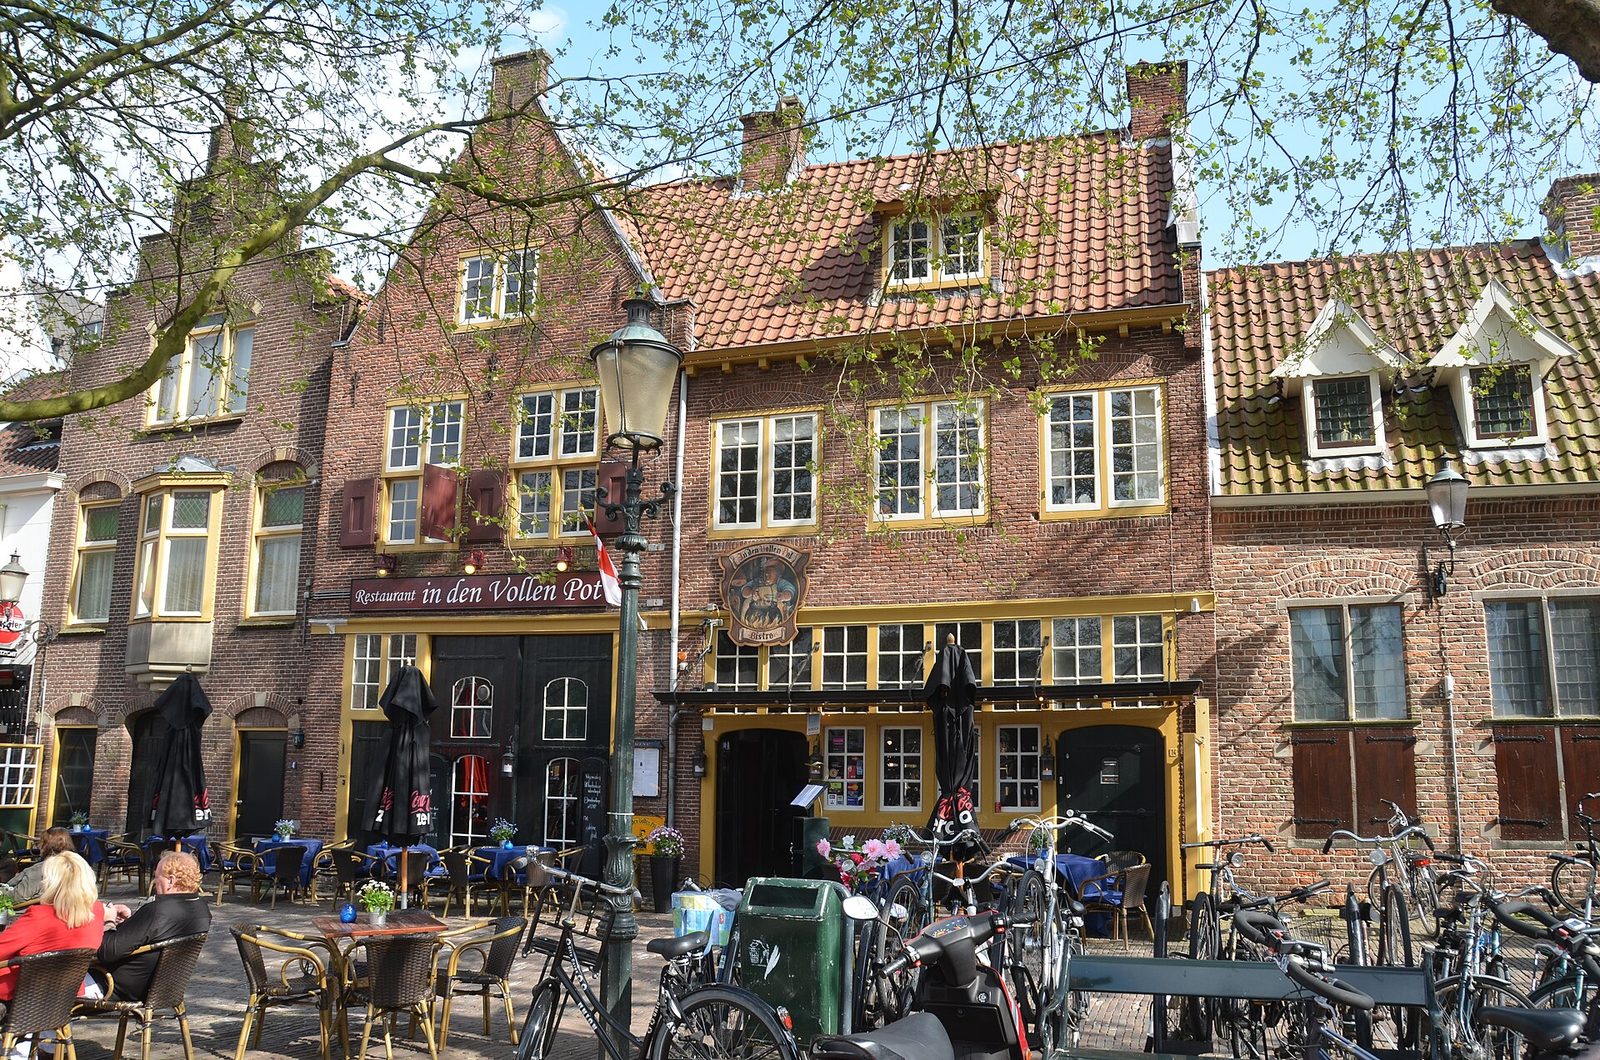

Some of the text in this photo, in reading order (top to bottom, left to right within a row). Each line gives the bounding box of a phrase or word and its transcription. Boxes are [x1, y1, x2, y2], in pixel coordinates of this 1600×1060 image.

[355, 576, 603, 605] Restaurant in den Vollen Pot
[750, 631, 774, 640] Bistro
